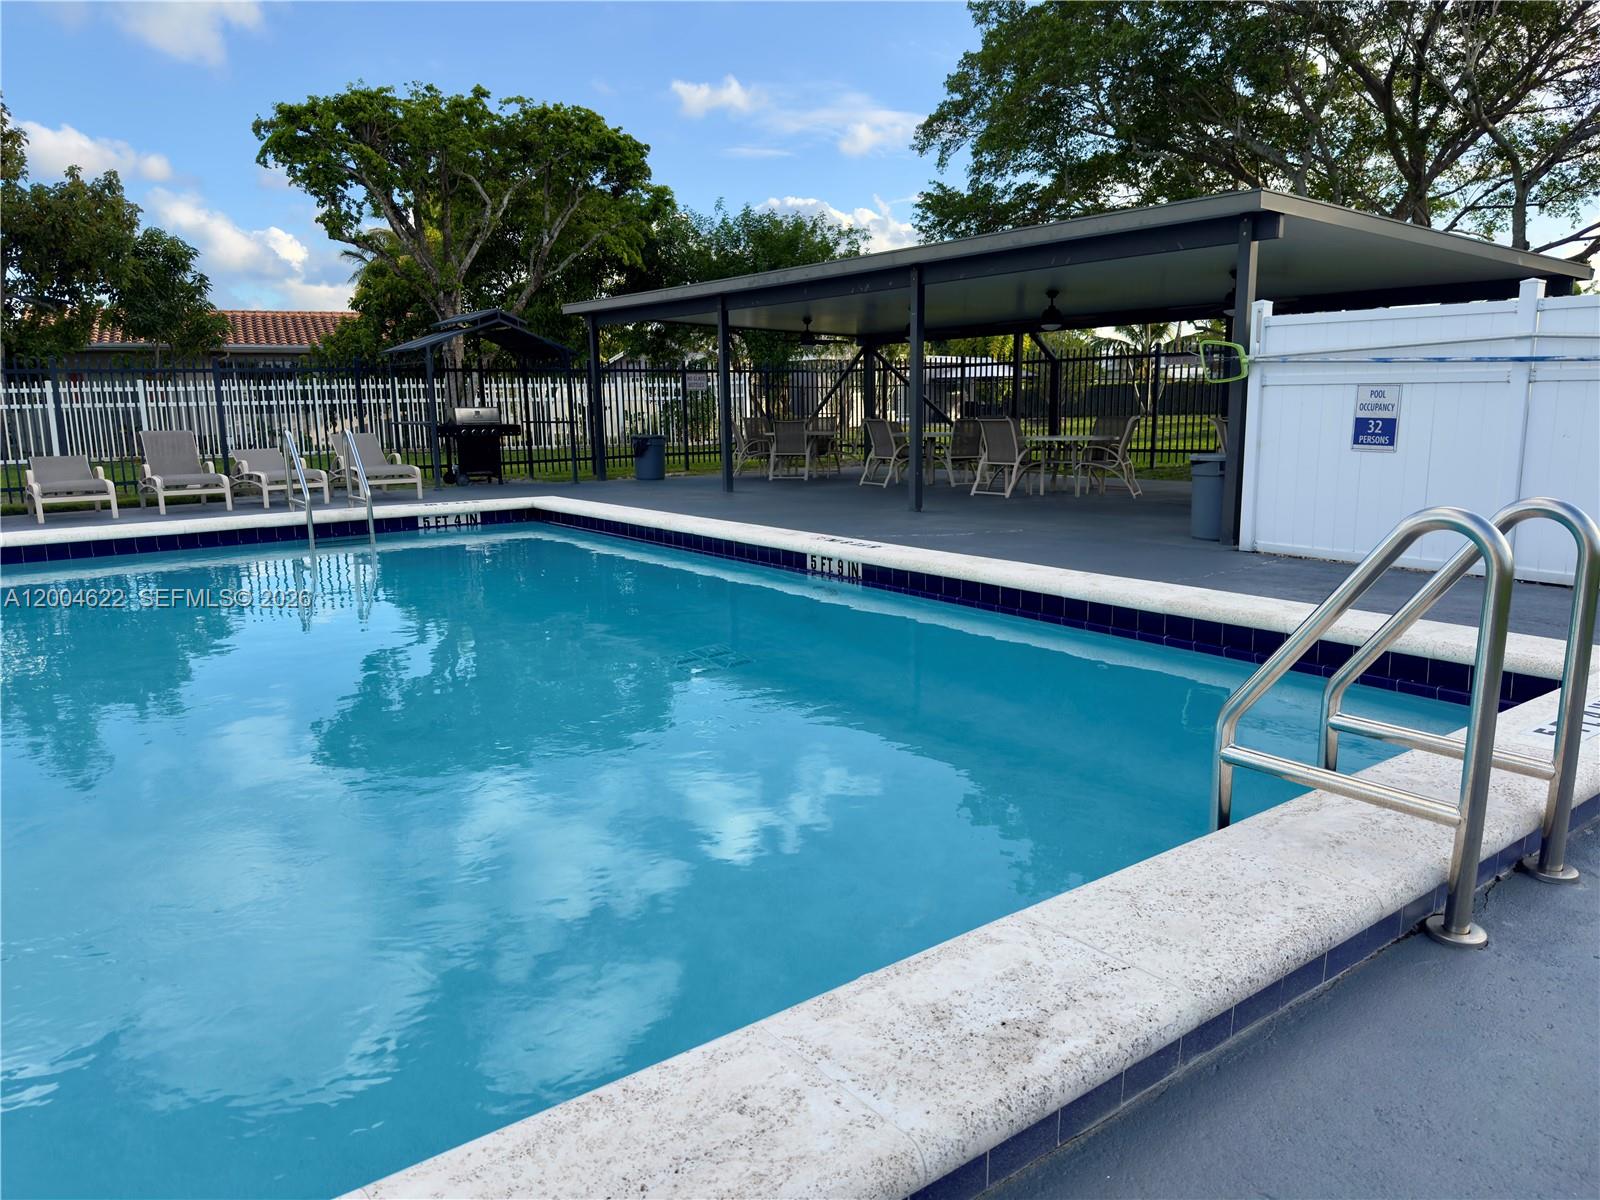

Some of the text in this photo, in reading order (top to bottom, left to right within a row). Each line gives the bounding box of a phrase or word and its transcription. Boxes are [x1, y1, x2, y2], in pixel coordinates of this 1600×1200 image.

[1370, 390, 1386, 399] POOL
[1359, 402, 1395, 411] OCCUPANCY
[1367, 420, 1383, 433] 32
[1358, 435, 1389, 444] PERSONS
[423, 516, 430, 528] 5
[454, 514, 462, 525] 4
[465, 513, 478, 525] IN
[810, 554, 817, 570] 5
[837, 559, 844, 576] 9
